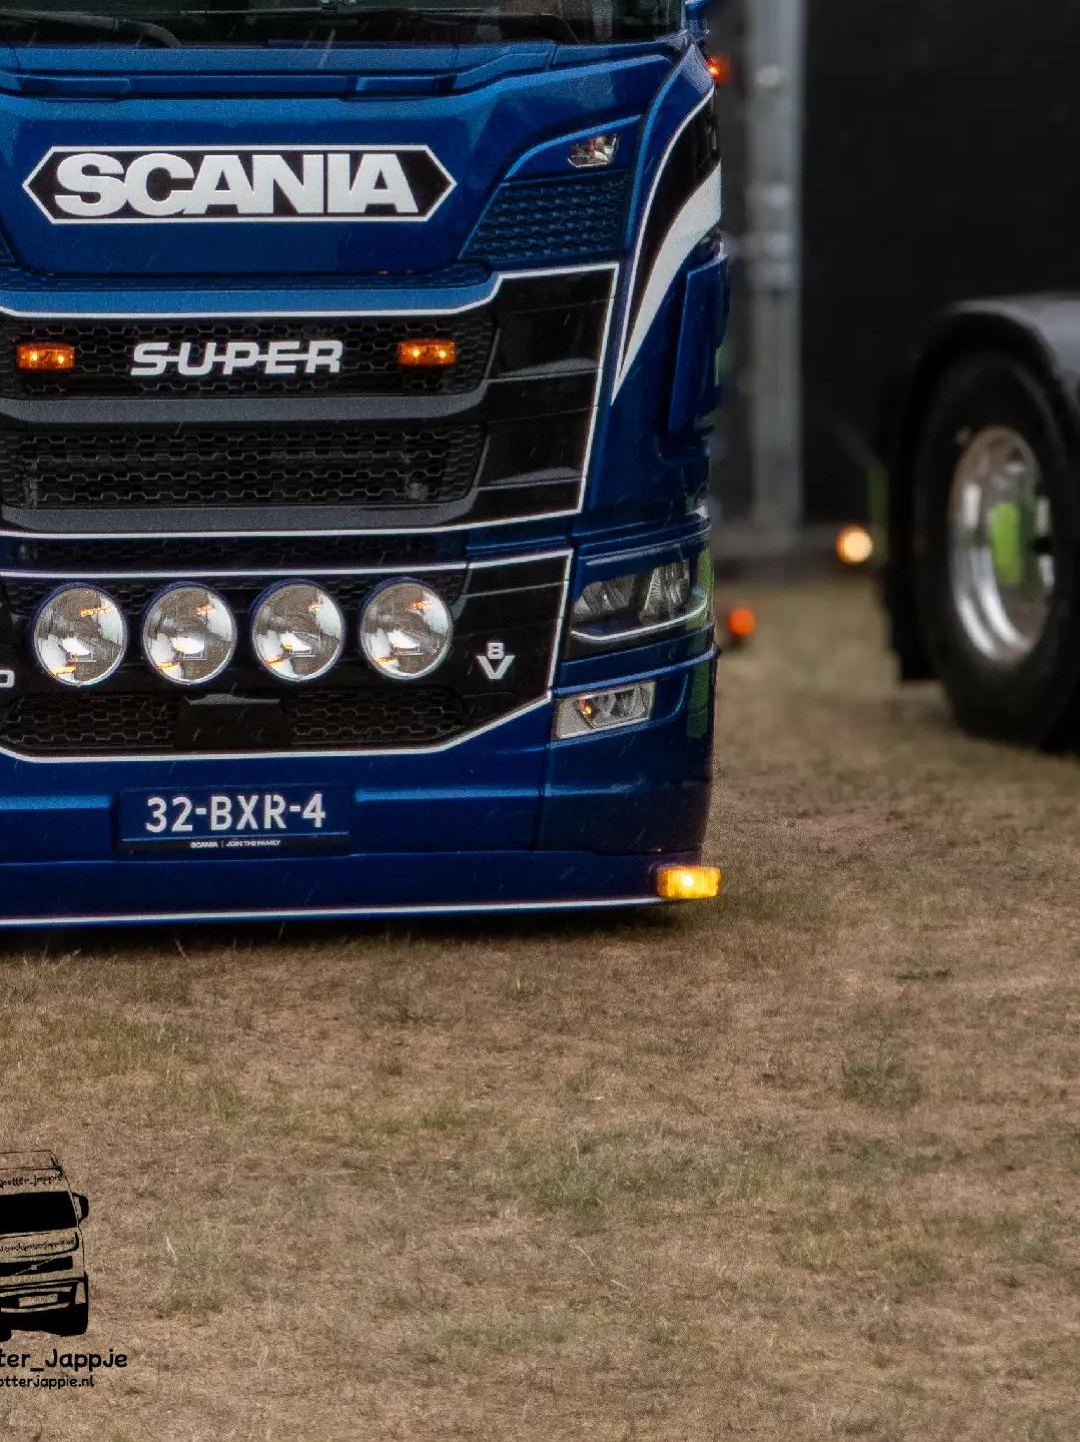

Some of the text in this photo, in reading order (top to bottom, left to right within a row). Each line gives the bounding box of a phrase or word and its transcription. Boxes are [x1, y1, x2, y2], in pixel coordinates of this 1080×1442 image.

[53, 152, 419, 217] SCANIA
[130, 340, 344, 376] SUPER
[146, 792, 326, 833] 32-BXR-4
